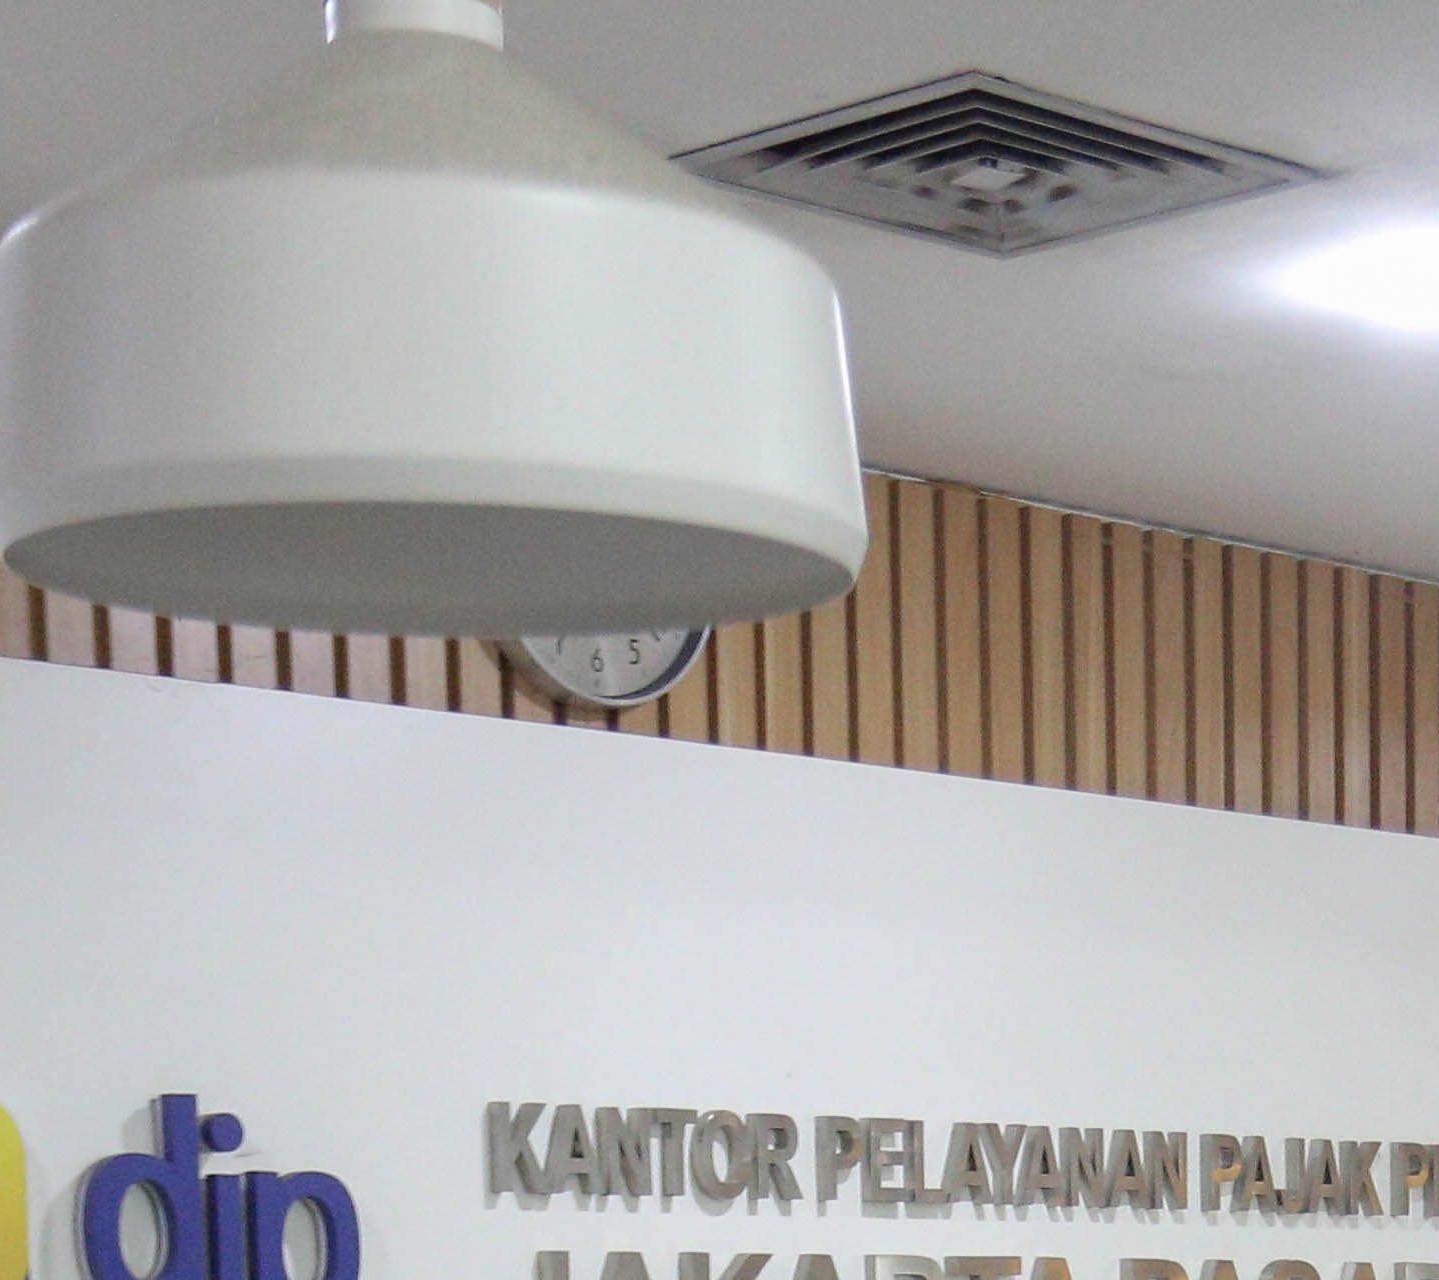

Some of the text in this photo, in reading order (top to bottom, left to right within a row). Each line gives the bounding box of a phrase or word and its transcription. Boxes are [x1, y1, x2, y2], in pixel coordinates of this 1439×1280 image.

[592, 648, 604, 672] 6
[629, 639, 640, 664] 5
[483, 1100, 799, 1203] KANTOR
[813, 1115, 1189, 1212] PELAYANAN
[1201, 1132, 1386, 1218] PAJAK
